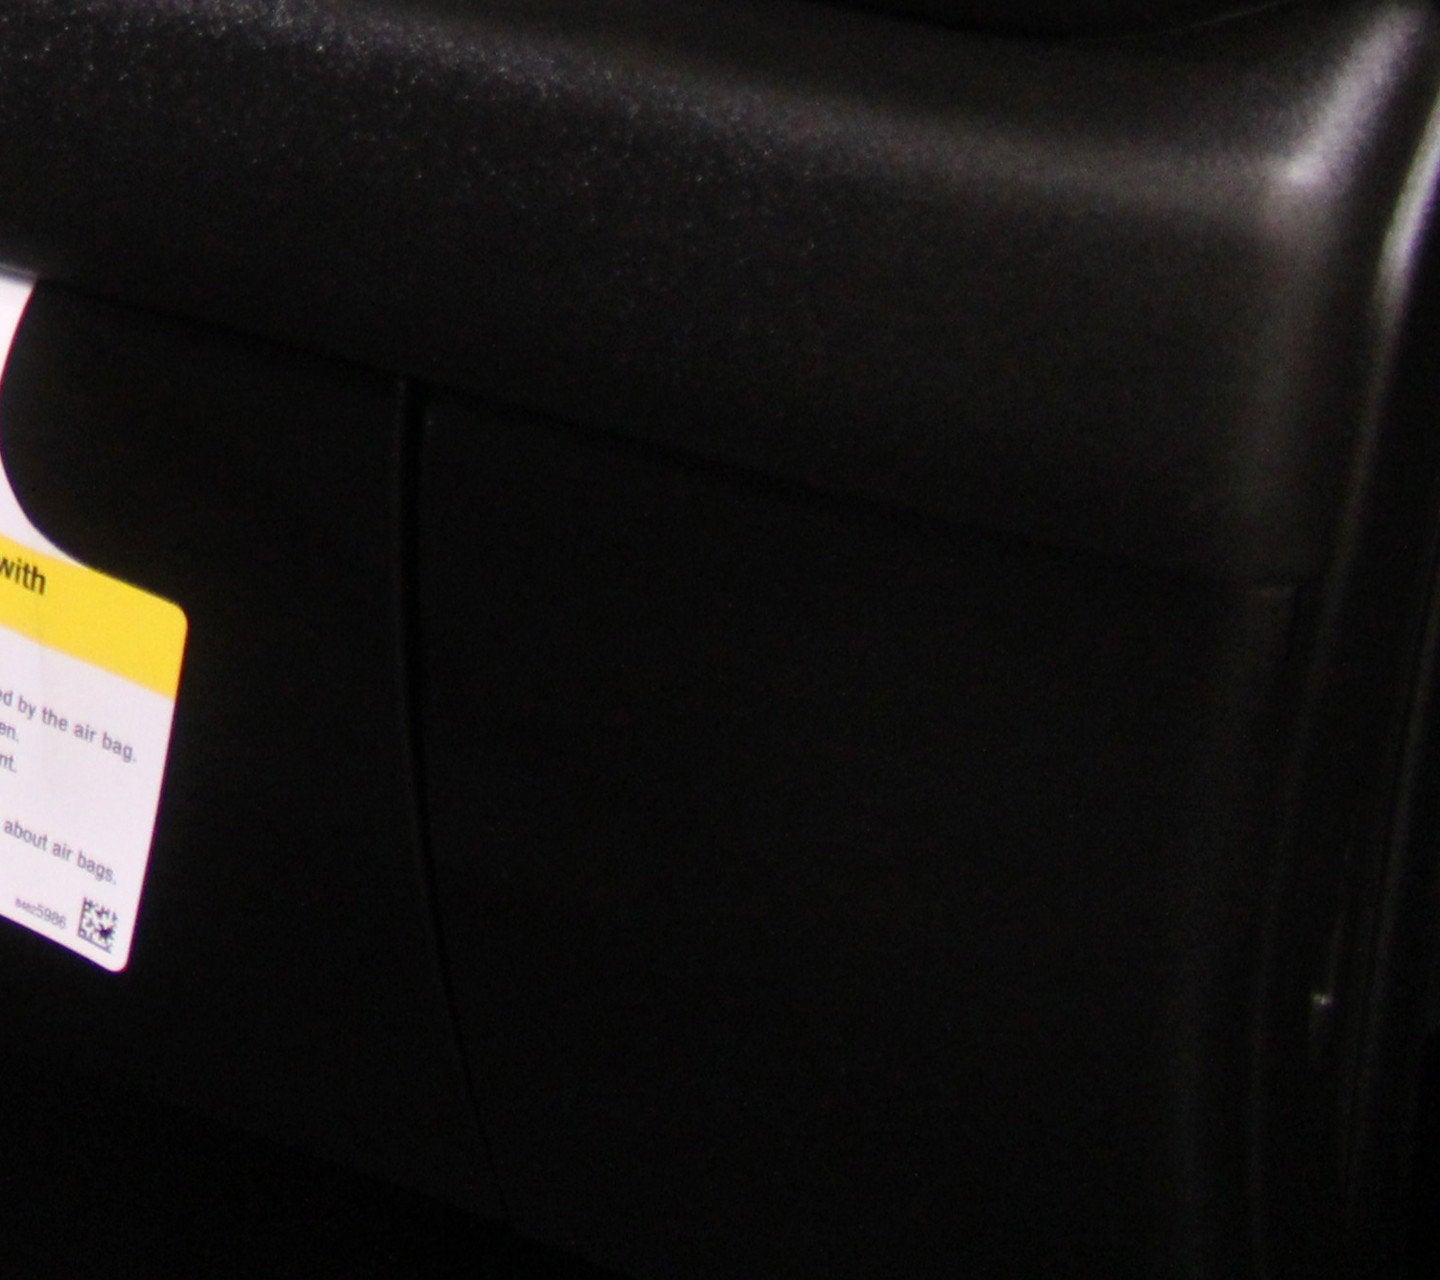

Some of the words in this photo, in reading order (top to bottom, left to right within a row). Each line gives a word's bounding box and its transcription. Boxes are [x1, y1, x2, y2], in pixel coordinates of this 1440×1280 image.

[18, 695, 37, 719] by
[42, 707, 69, 732] the
[74, 723, 97, 744] air
[102, 732, 136, 763] bag.
[4, 819, 48, 852] about
[52, 841, 73, 861] air
[77, 850, 116, 885] bags.
